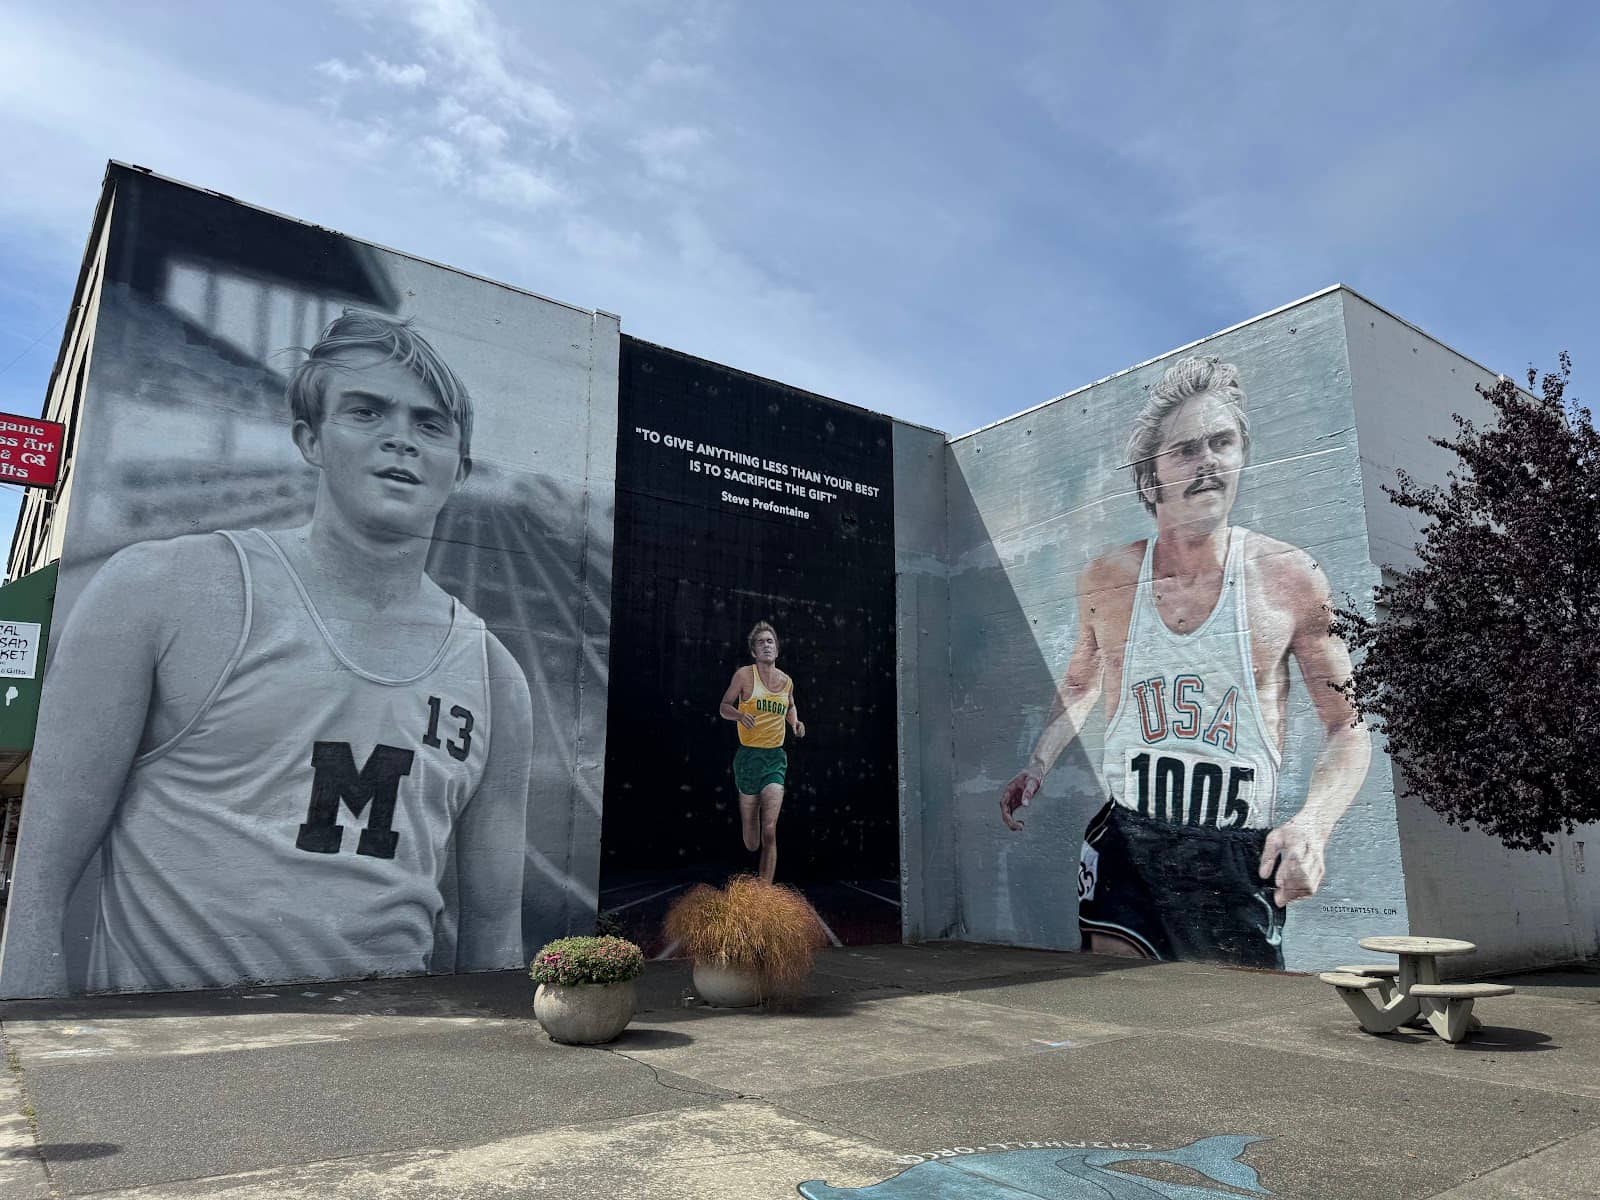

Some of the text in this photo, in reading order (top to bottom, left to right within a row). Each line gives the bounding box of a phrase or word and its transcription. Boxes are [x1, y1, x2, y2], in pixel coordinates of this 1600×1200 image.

[23, 437, 55, 453] Art
[663, 434, 694, 452] GIVE
[696, 443, 760, 469] ANYTHING
[762, 459, 789, 476] LESS
[790, 465, 821, 484] THAN
[823, 473, 853, 492] YOUR
[855, 482, 880, 498] BEST
[689, 459, 701, 473] IS
[703, 462, 721, 477] TO
[723, 467, 783, 492] SACRIFICE
[784, 481, 806, 498] THE
[721, 490, 810, 520] Steve Prefontaine
[423, 696, 474, 762] 13
[1132, 674, 1240, 753] USA
[296, 741, 414, 859] M
[1131, 753, 1255, 831] 1005
